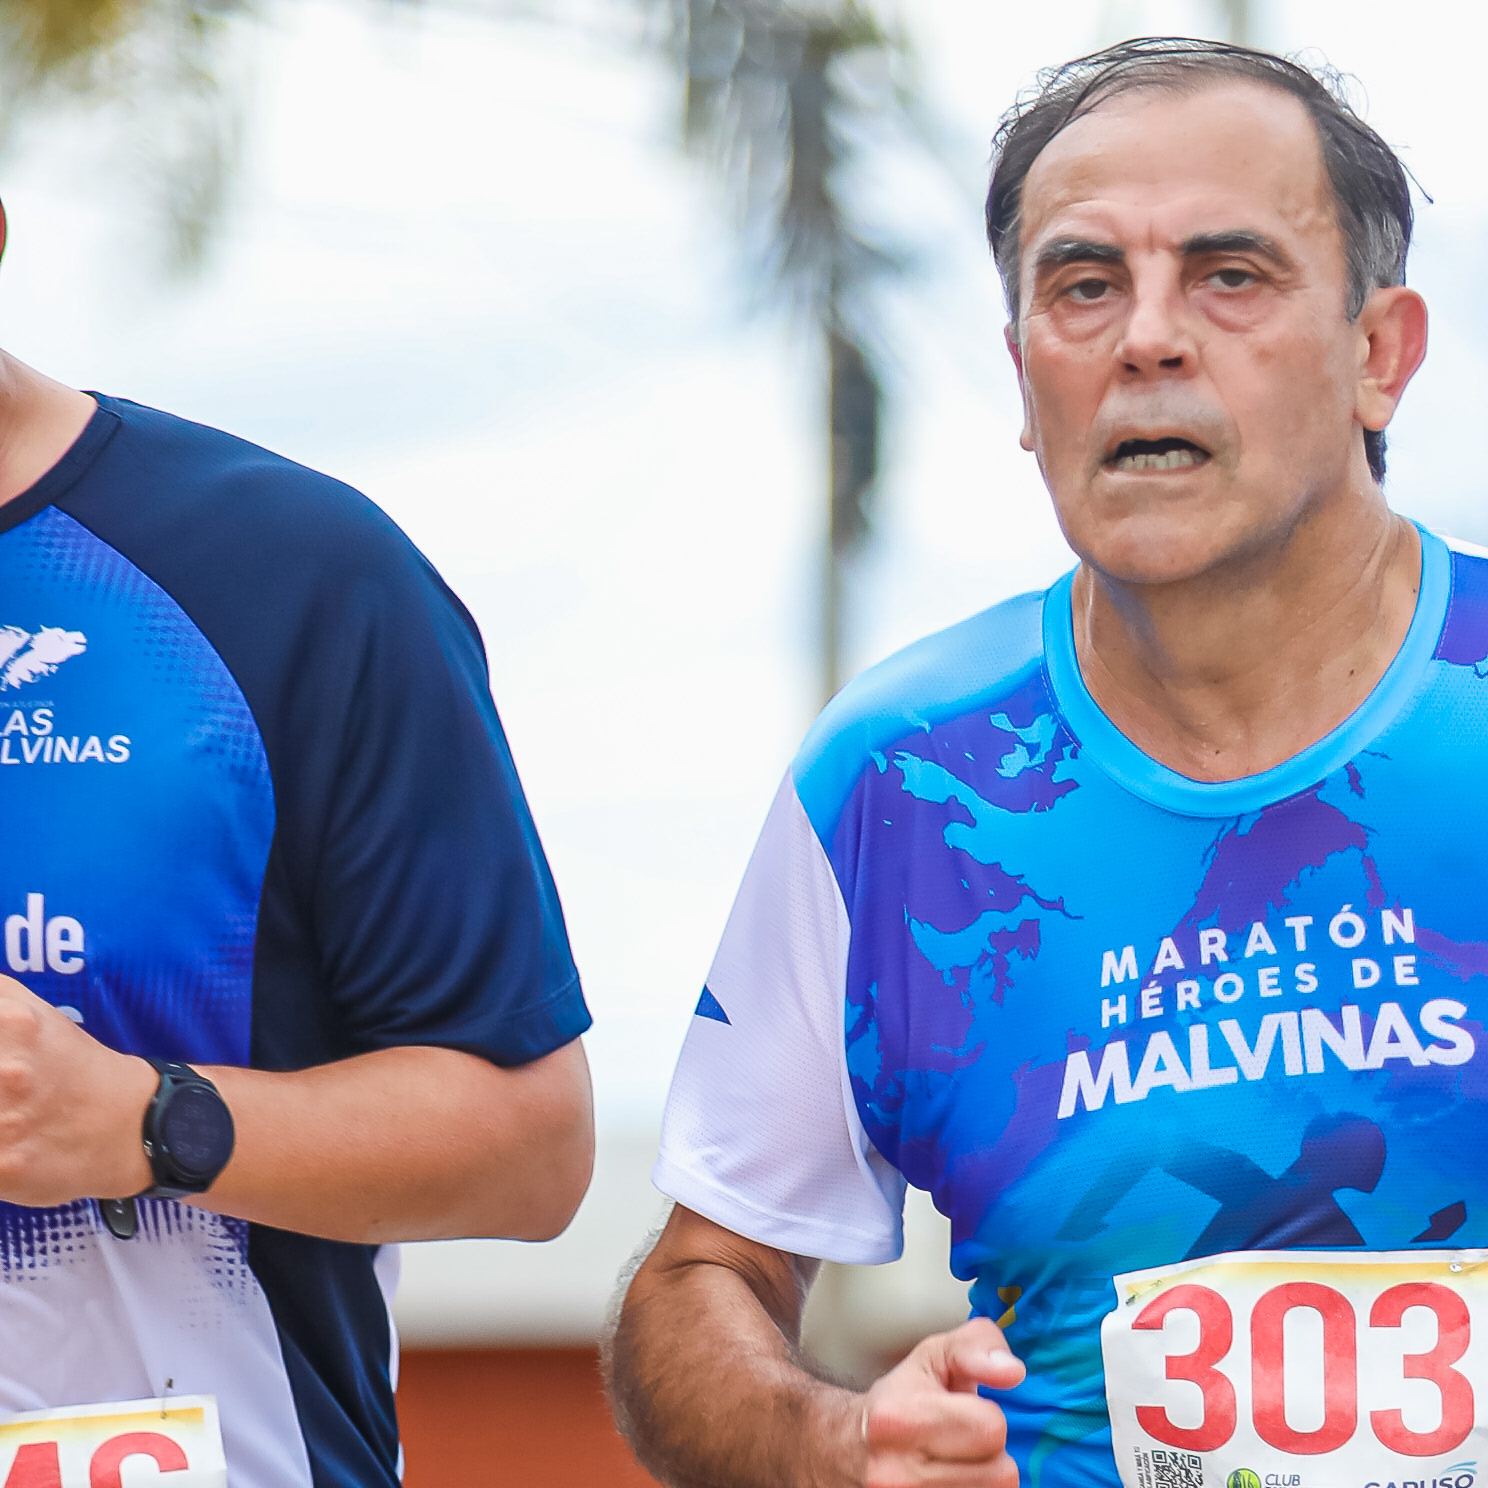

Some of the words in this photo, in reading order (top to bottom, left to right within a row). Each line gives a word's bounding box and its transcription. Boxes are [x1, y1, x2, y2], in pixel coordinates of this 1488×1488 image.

[0, 708, 54, 737] AS
[5, 893, 85, 975] de
[1101, 904, 1416, 987] MARATÓN
[1101, 963, 1319, 1028] HÉROES
[1352, 955, 1420, 989] DE
[1057, 999, 1476, 1119] MALVINAS
[1131, 1281, 1475, 1457] 303
[1265, 1473, 1301, 1487] CLUB
